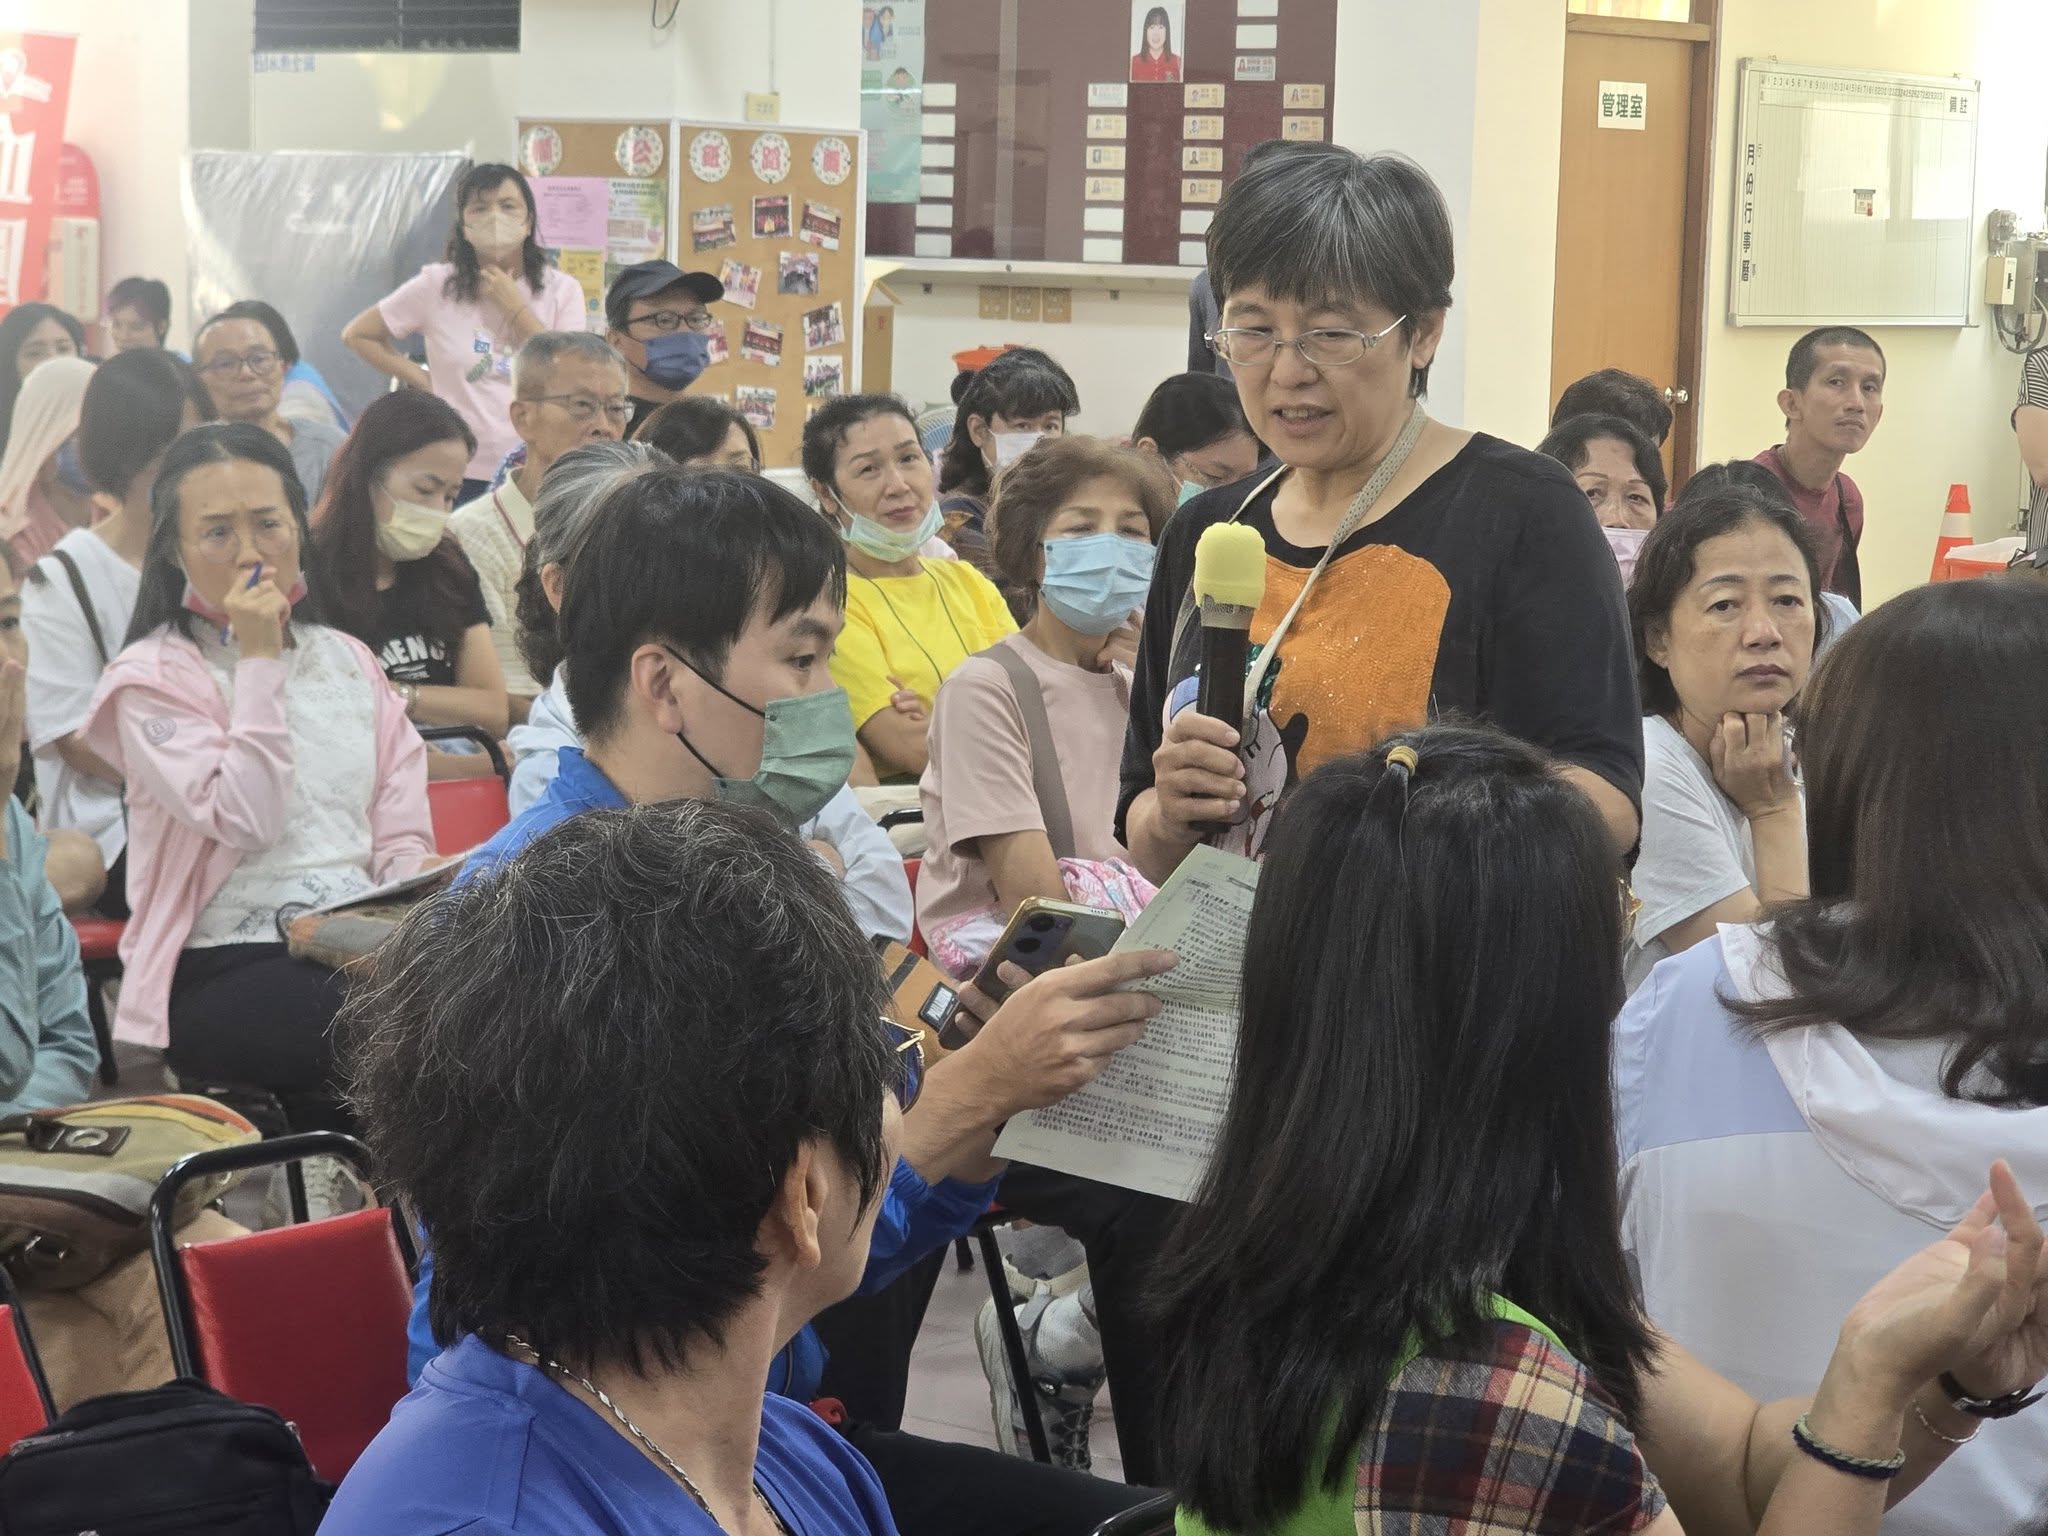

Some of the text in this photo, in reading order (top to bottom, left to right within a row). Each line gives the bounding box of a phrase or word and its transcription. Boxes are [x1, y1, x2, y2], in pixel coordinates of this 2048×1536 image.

[1602, 92, 1642, 118] 管理室
[1949, 96, 1968, 114] 備註
[1741, 144, 1755, 282] 月份行事曆
